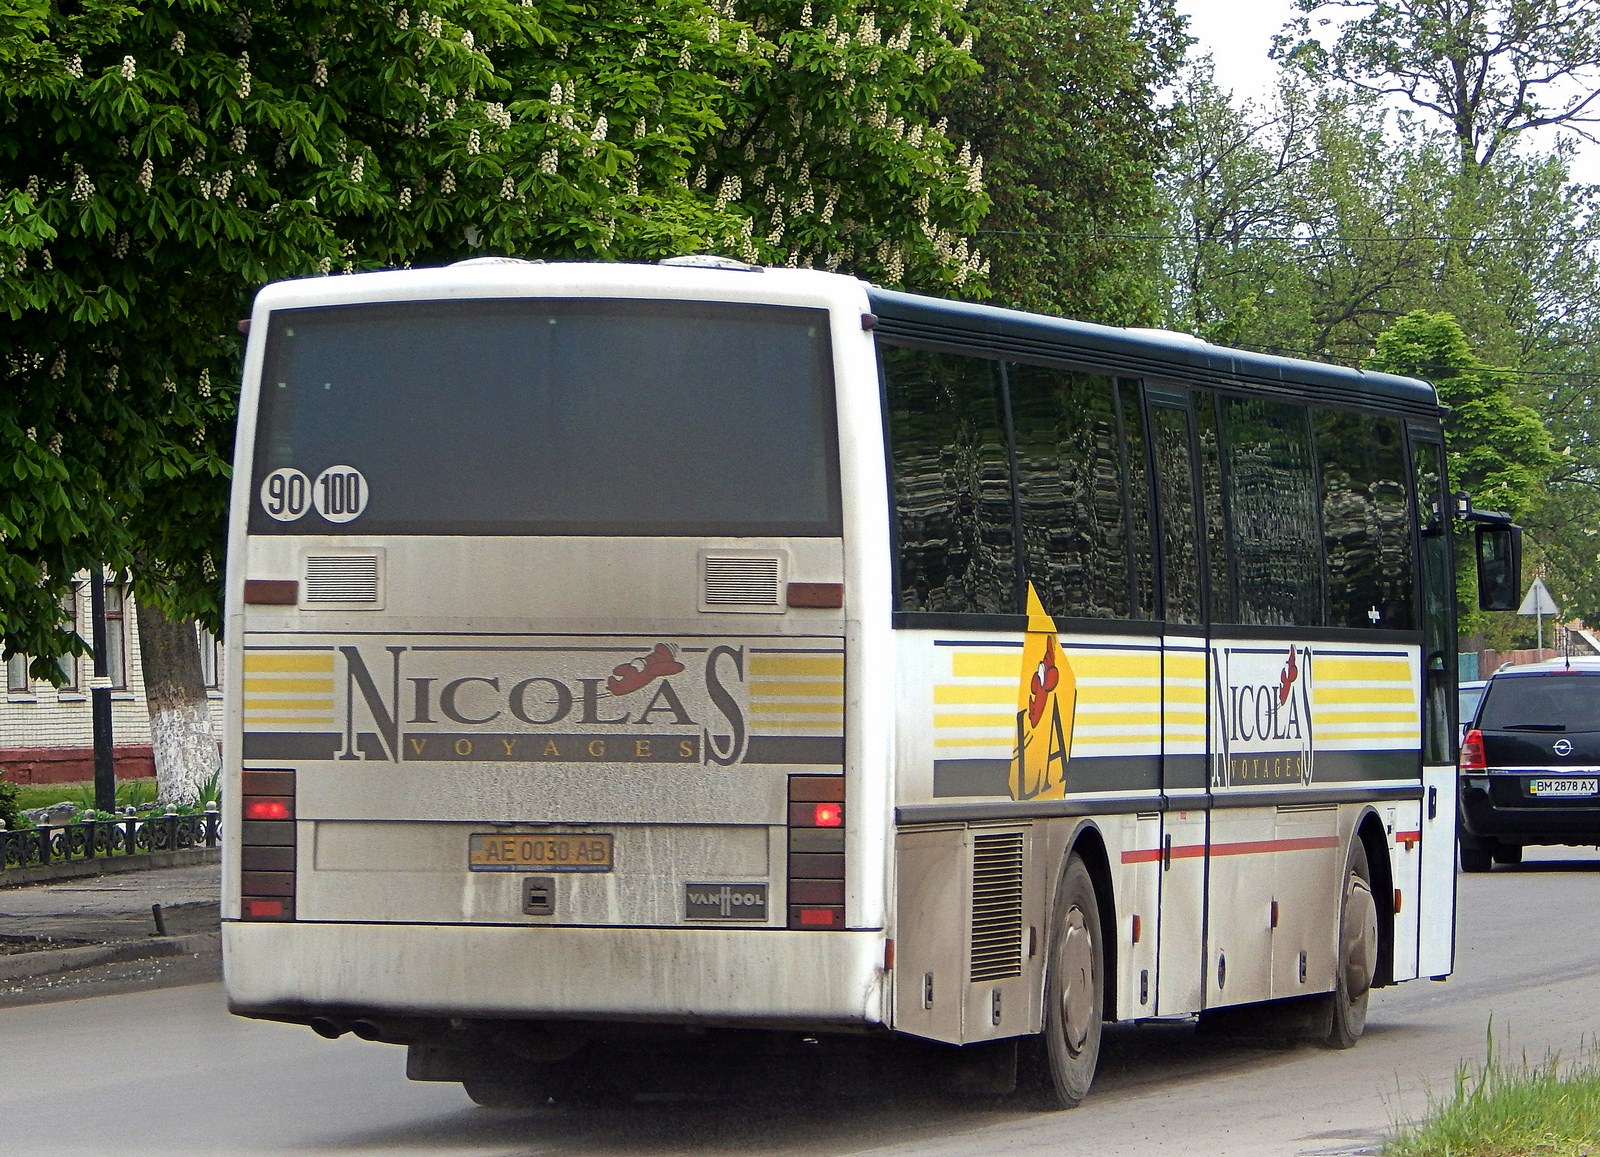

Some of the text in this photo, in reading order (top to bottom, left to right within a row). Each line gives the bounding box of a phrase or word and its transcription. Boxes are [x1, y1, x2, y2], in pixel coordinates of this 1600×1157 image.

[268, 473, 305, 515] 90
[321, 472, 360, 515] 100
[339, 645, 744, 766] NICOLAS
[1212, 645, 1313, 789] NICOLAS
[411, 739, 693, 758] VOYAGES
[1231, 757, 1301, 779] VOYAGES
[1537, 781, 1596, 792] BM 2878 AX
[486, 840, 606, 862] AE 0030 AB
